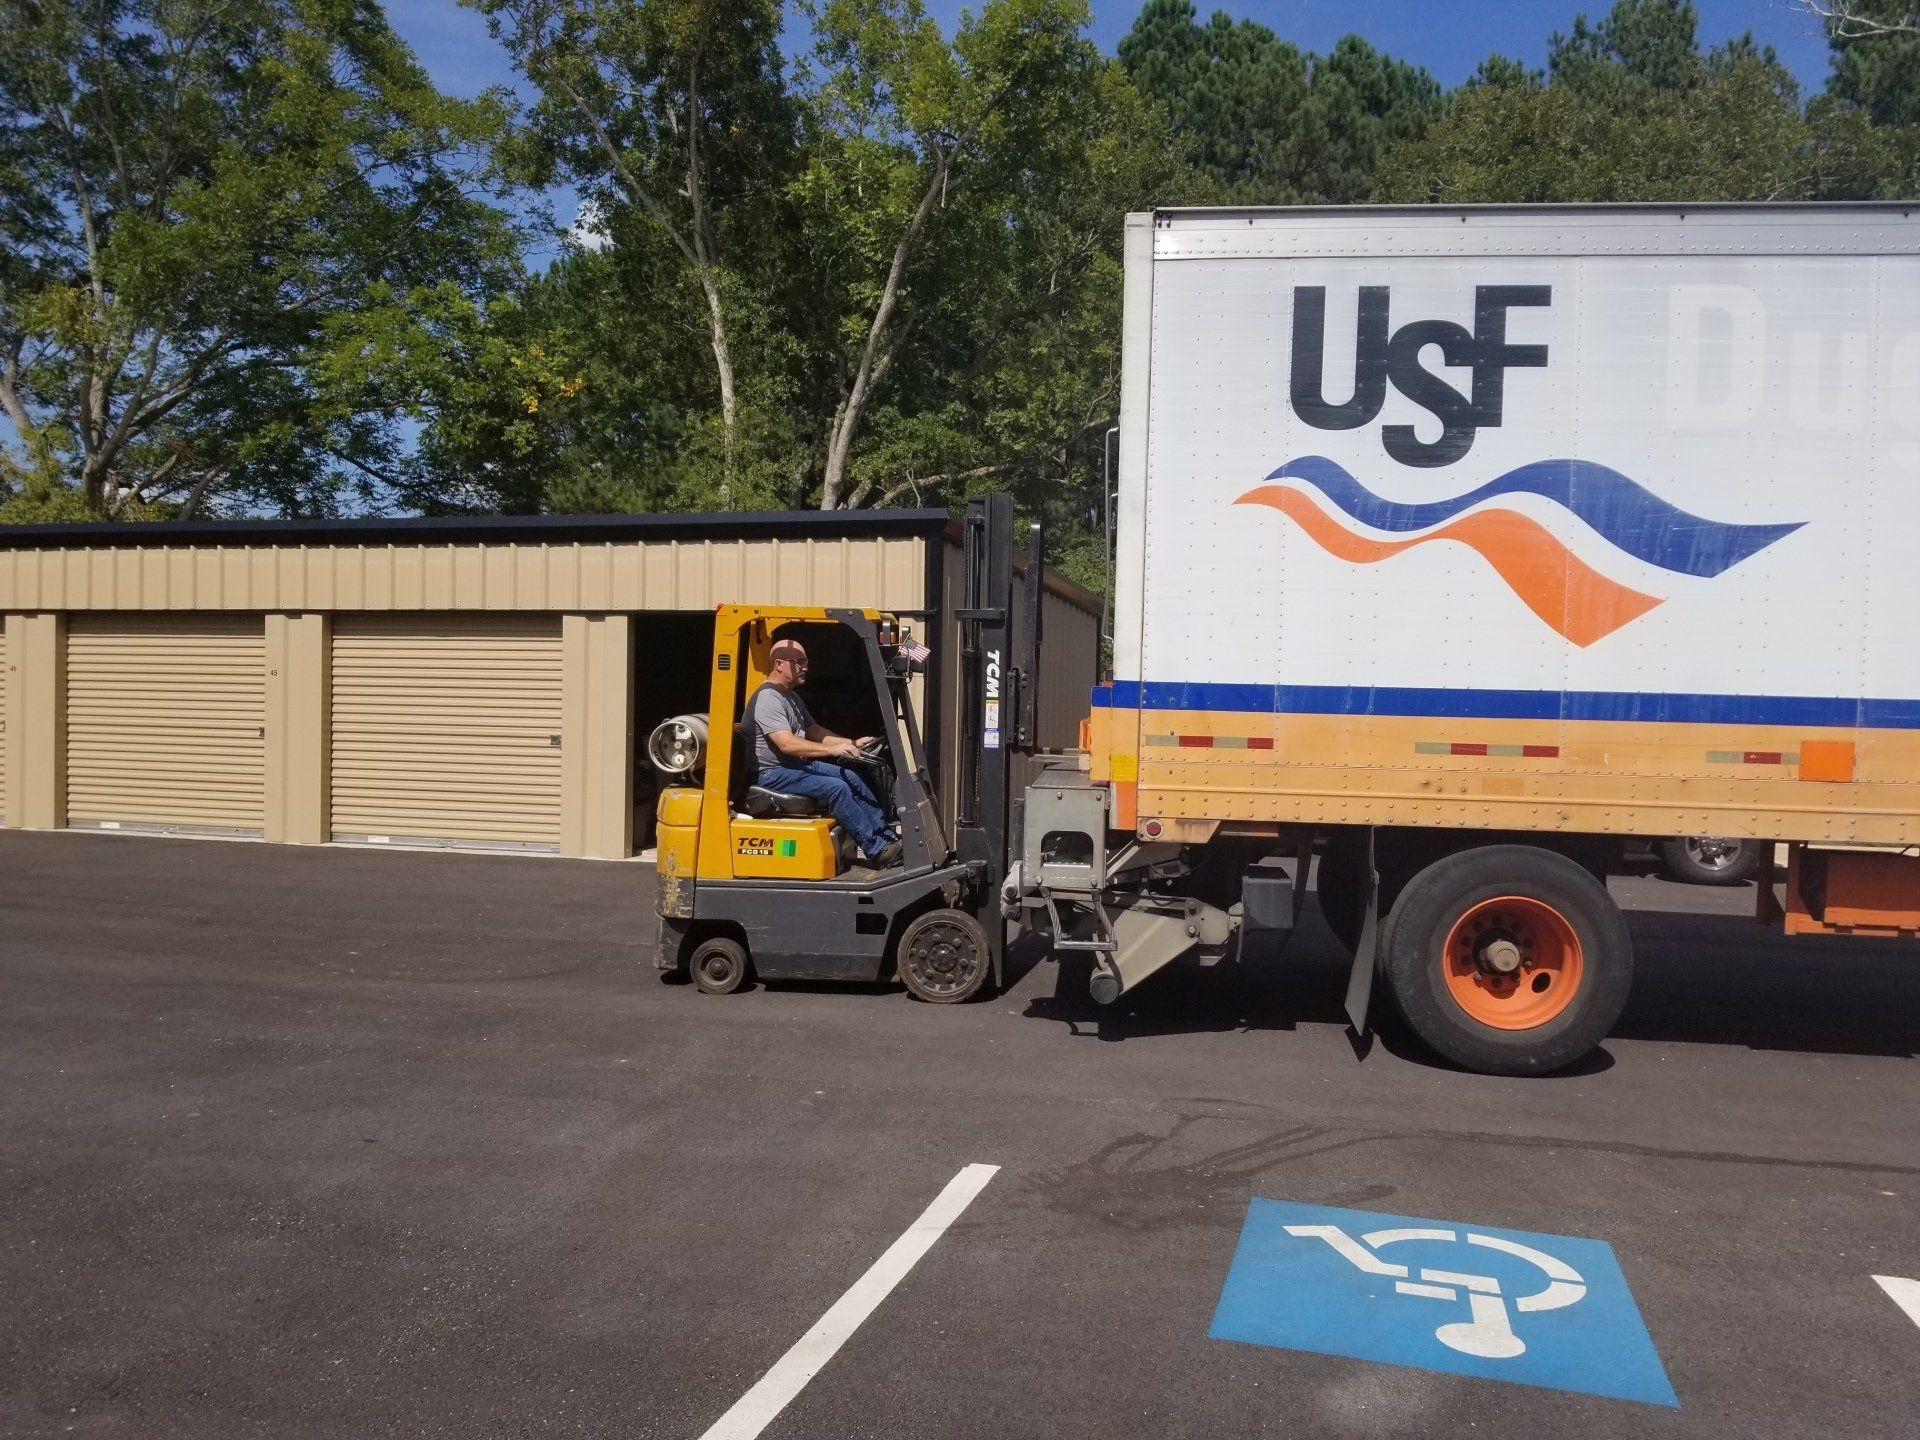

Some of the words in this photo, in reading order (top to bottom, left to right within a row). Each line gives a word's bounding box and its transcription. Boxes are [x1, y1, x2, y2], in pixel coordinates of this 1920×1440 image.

[1290, 285, 1552, 468] USF
[986, 650, 1000, 697] TCM
[738, 837, 774, 847] TCM
